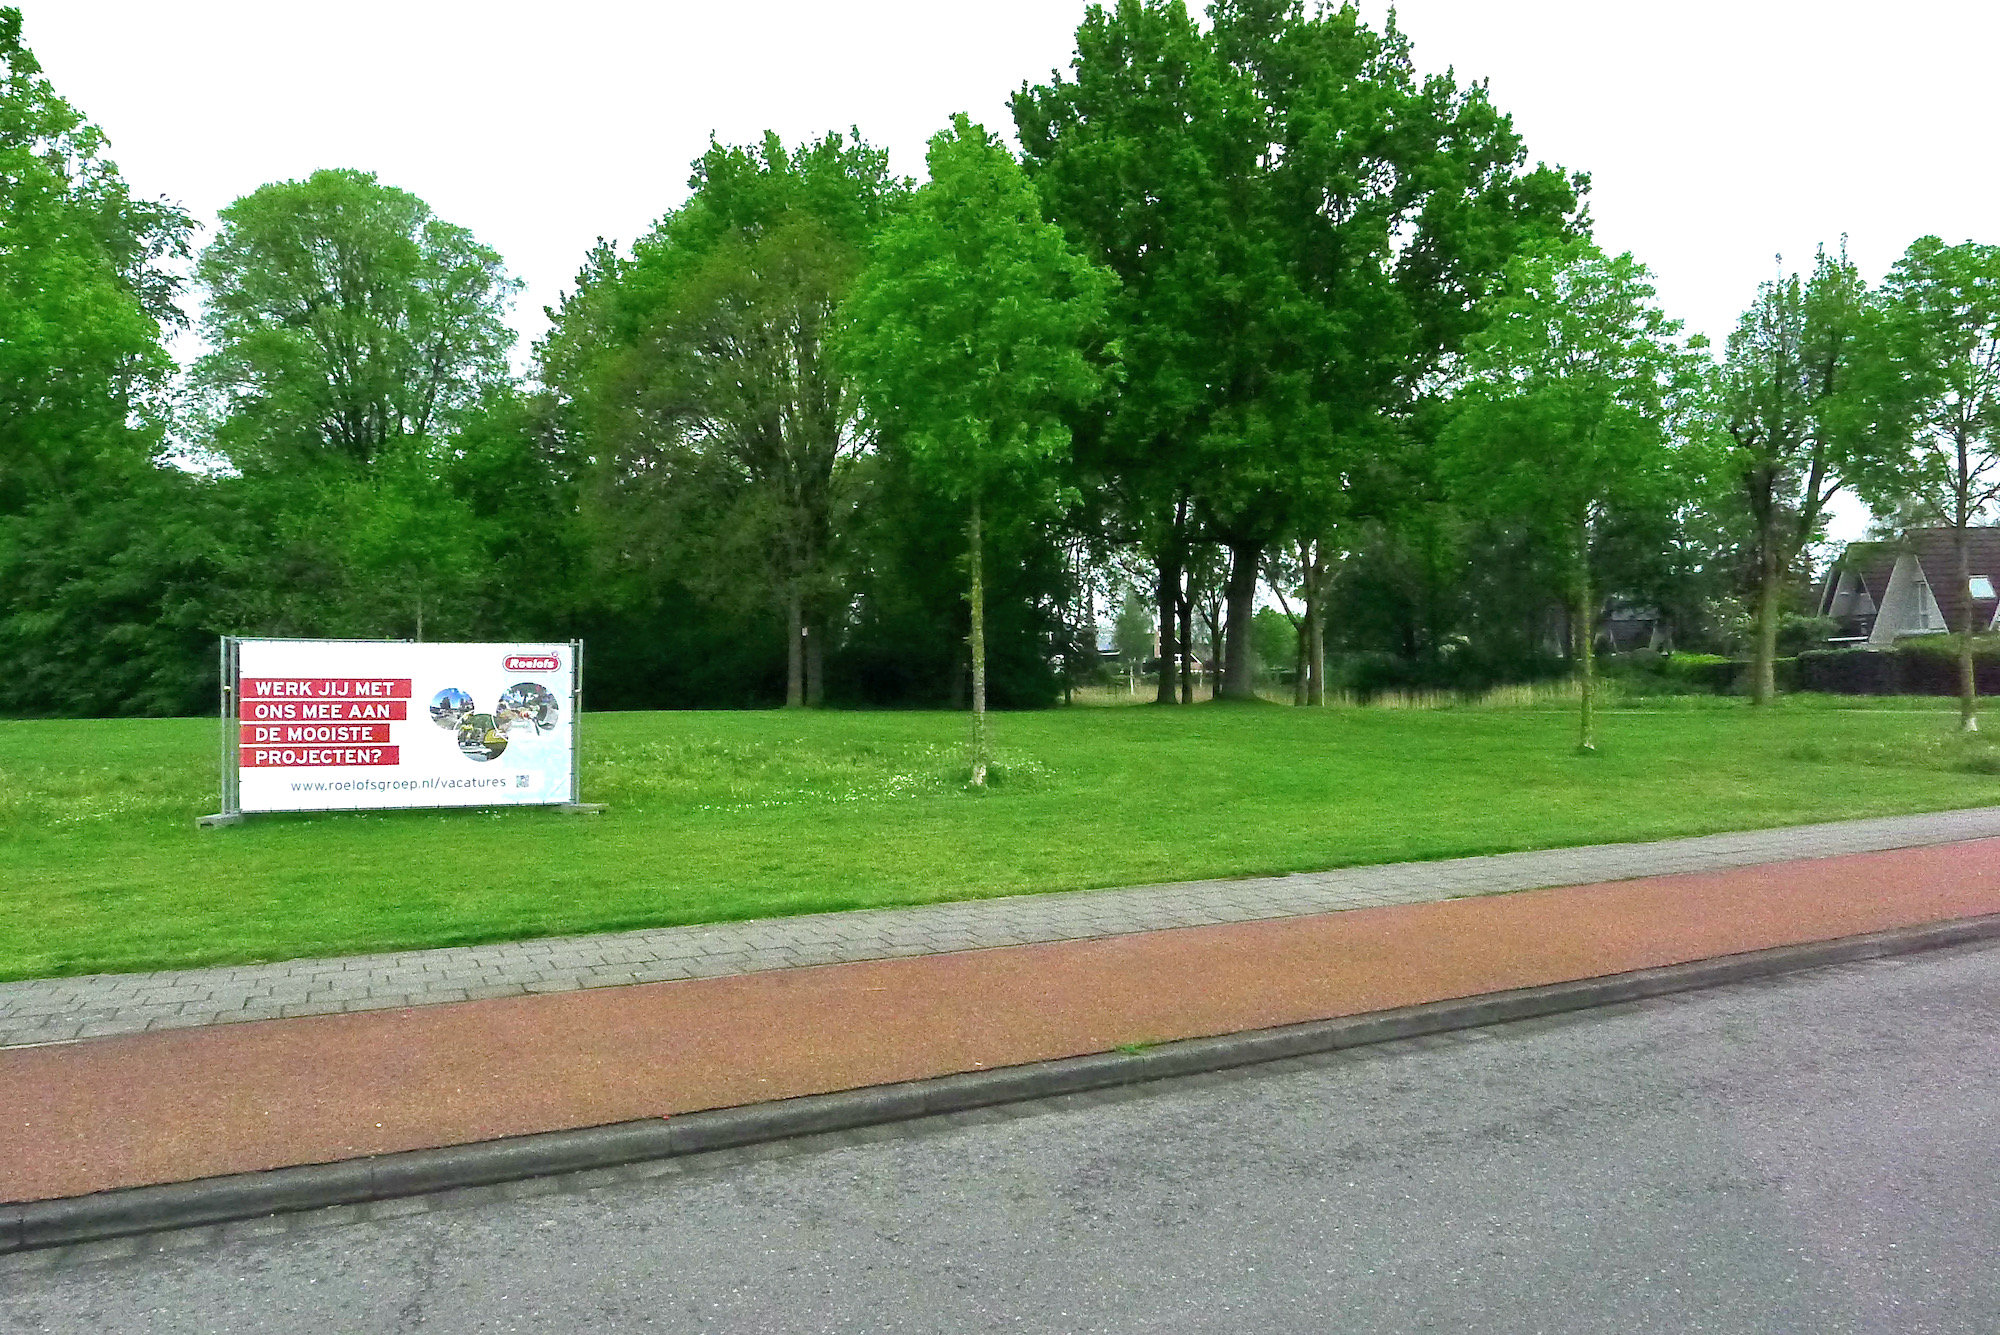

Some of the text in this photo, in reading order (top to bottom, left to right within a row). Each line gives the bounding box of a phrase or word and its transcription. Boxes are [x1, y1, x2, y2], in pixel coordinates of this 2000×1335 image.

[509, 657, 556, 670] Roelofs
[254, 681, 395, 697] WERK JIJ MET
[254, 704, 391, 719] ONS MEE AAN
[254, 726, 374, 743] DE MOOISTE
[254, 749, 382, 765] PROJECTEN?
[290, 776, 507, 792] www.roelofsgroep.nl/vacatures
